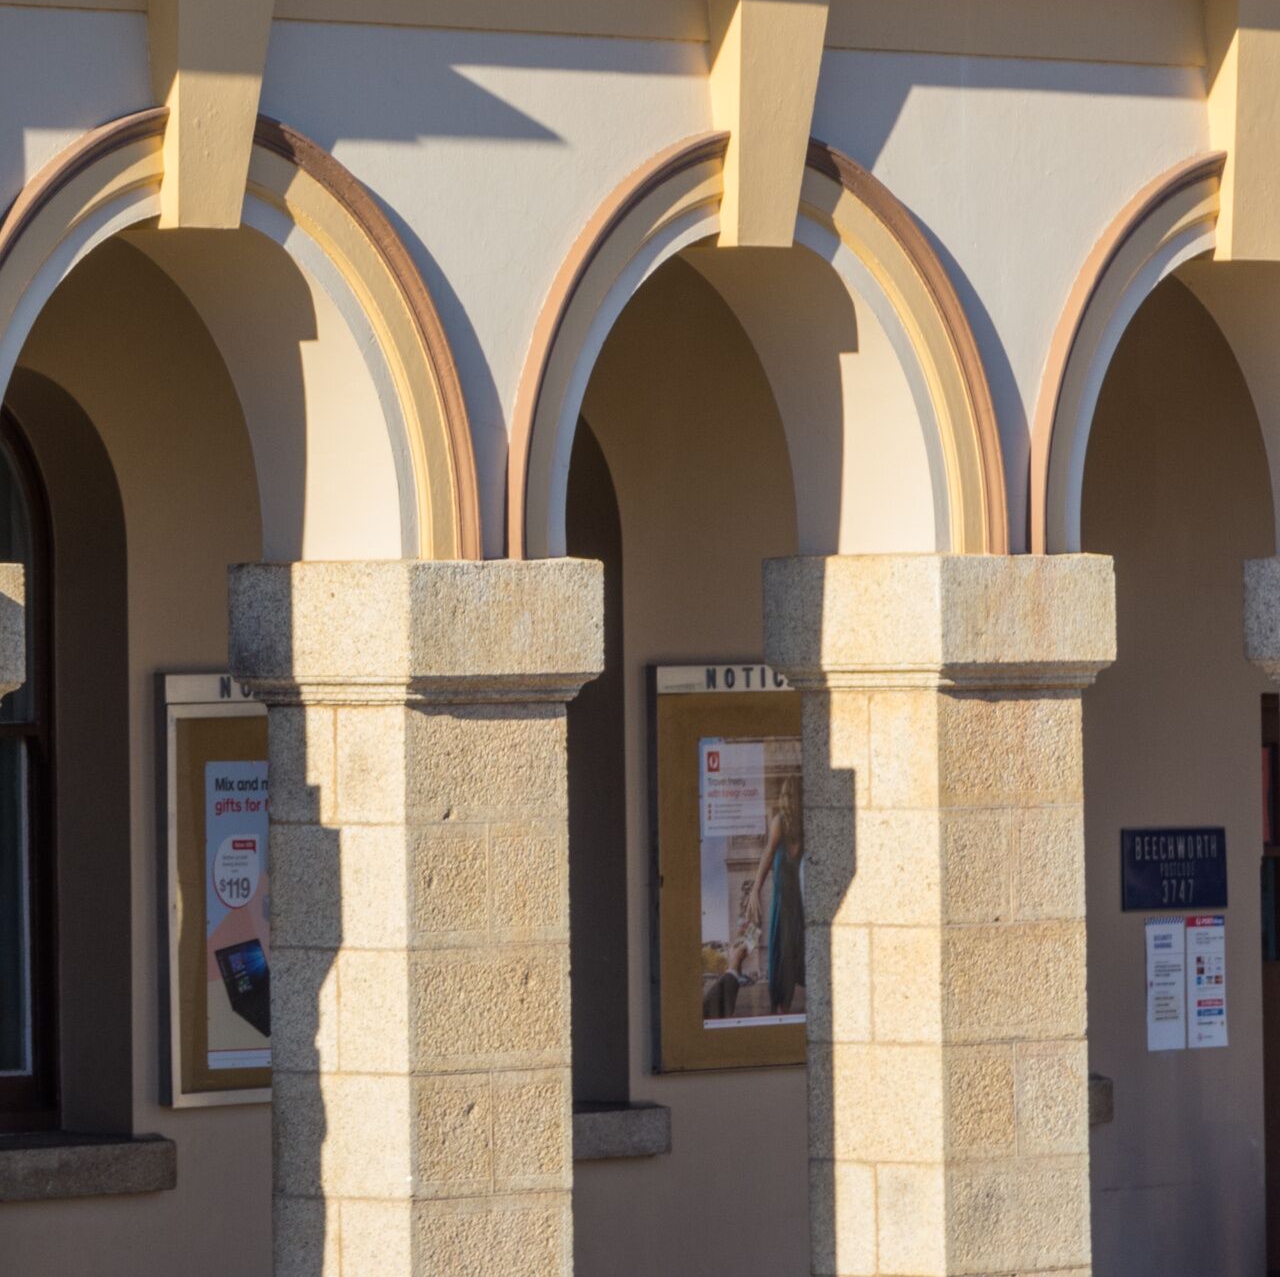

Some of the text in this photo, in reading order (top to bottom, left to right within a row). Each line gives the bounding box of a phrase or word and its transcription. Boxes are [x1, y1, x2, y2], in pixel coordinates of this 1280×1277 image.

[215, 777, 234, 791] Mix
[237, 777, 259, 791] and
[215, 798, 241, 816] gifts
[245, 798, 261, 812] for
[1135, 835, 1217, 860] BEECHWORTH
[219, 877, 251, 899] $119
[1161, 879, 1195, 903] 3747
